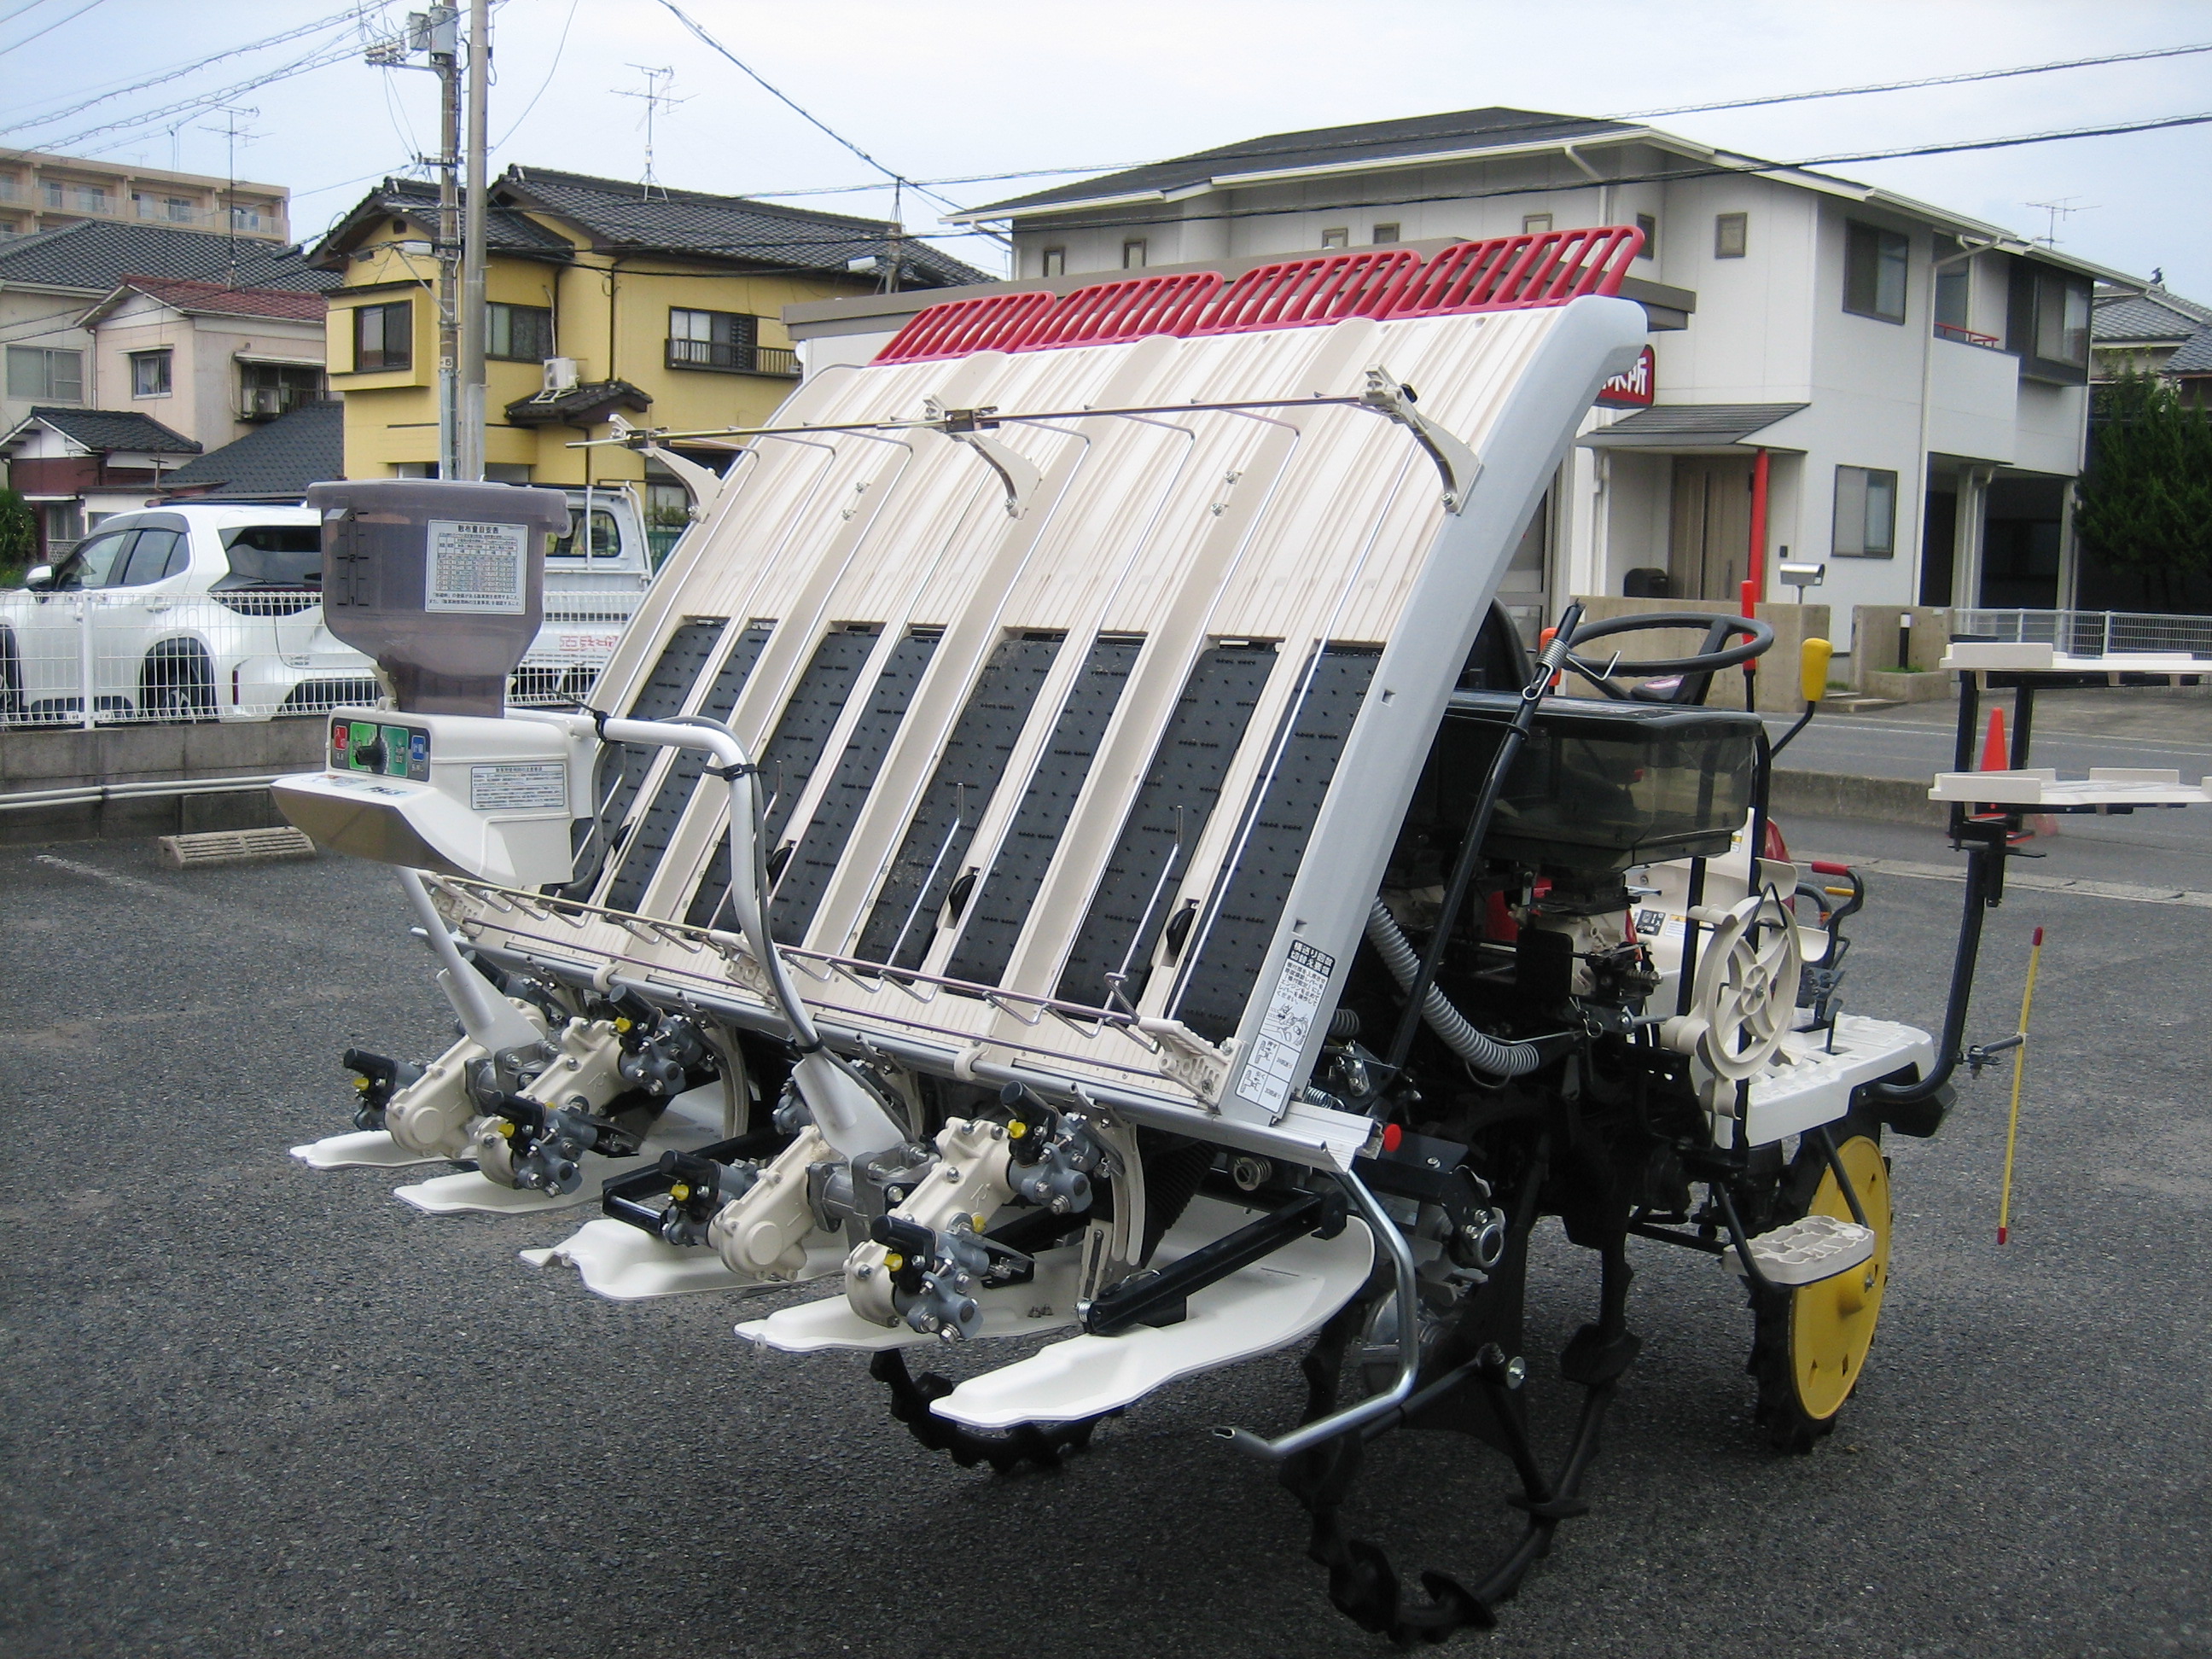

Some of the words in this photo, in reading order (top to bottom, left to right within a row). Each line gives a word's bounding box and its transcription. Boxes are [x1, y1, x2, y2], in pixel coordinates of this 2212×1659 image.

[349, 514, 356, 522] 3
[349, 554, 356, 562] 2
[350, 597, 355, 605] 1
[1294, 941, 1334, 966] 横送り回数
